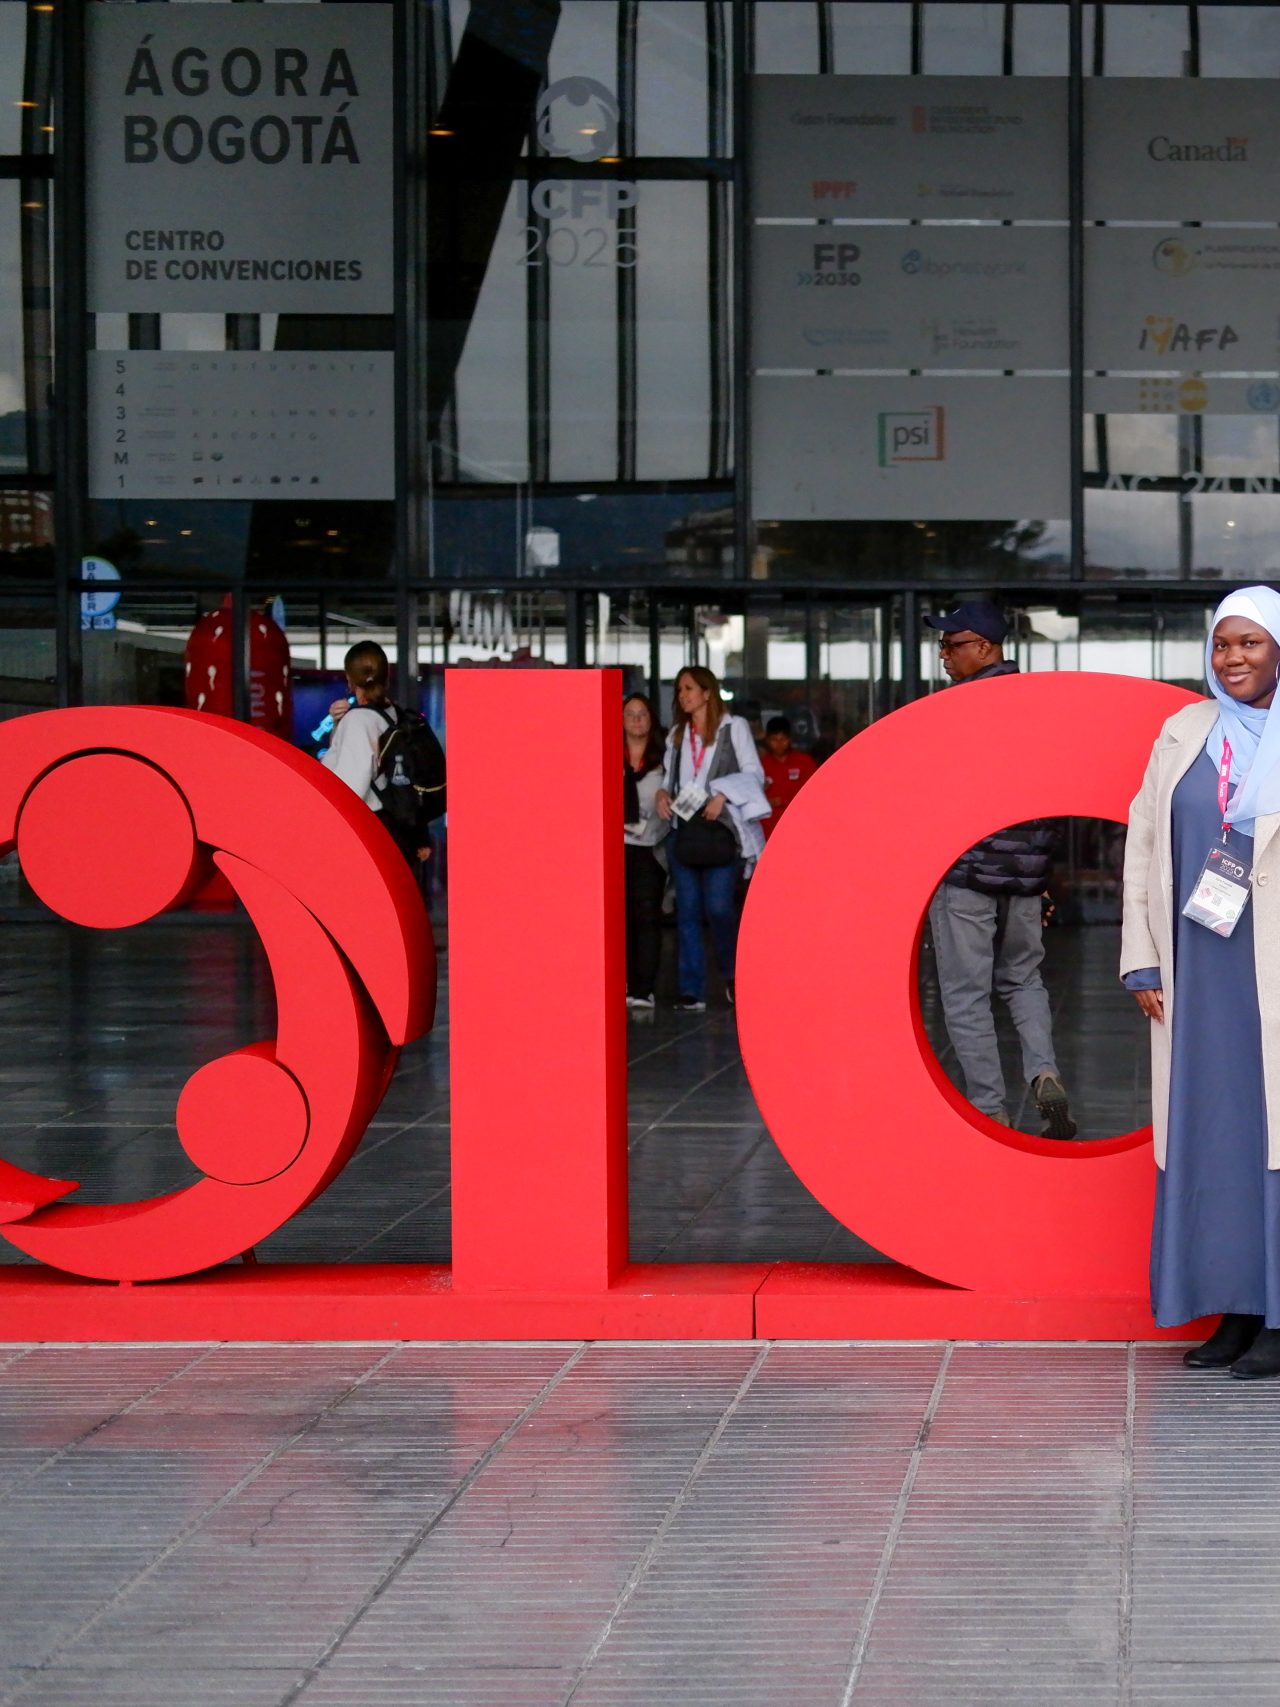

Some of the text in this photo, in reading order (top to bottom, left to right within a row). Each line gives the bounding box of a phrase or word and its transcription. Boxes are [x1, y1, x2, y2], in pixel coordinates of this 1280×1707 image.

[125, 34, 359, 97] ÁGORA
[124, 102, 360, 164] BOGOTÁ
[1147, 136, 1247, 162] Canada
[516, 179, 640, 219] ICFP
[125, 230, 225, 251] CENTRO
[515, 226, 640, 267] 2025
[814, 243, 861, 270] FP
[125, 259, 362, 282] DE CONVENCIONES
[814, 272, 862, 287] 2030
[115, 360, 126, 374] 5
[115, 382, 126, 396] 4
[116, 406, 126, 420] 3
[115, 429, 127, 443] 2
[893, 420, 929, 453] psi
[114, 452, 128, 465] M
[117, 475, 125, 488] 1
[1221, 858, 1236, 868] ICFP
